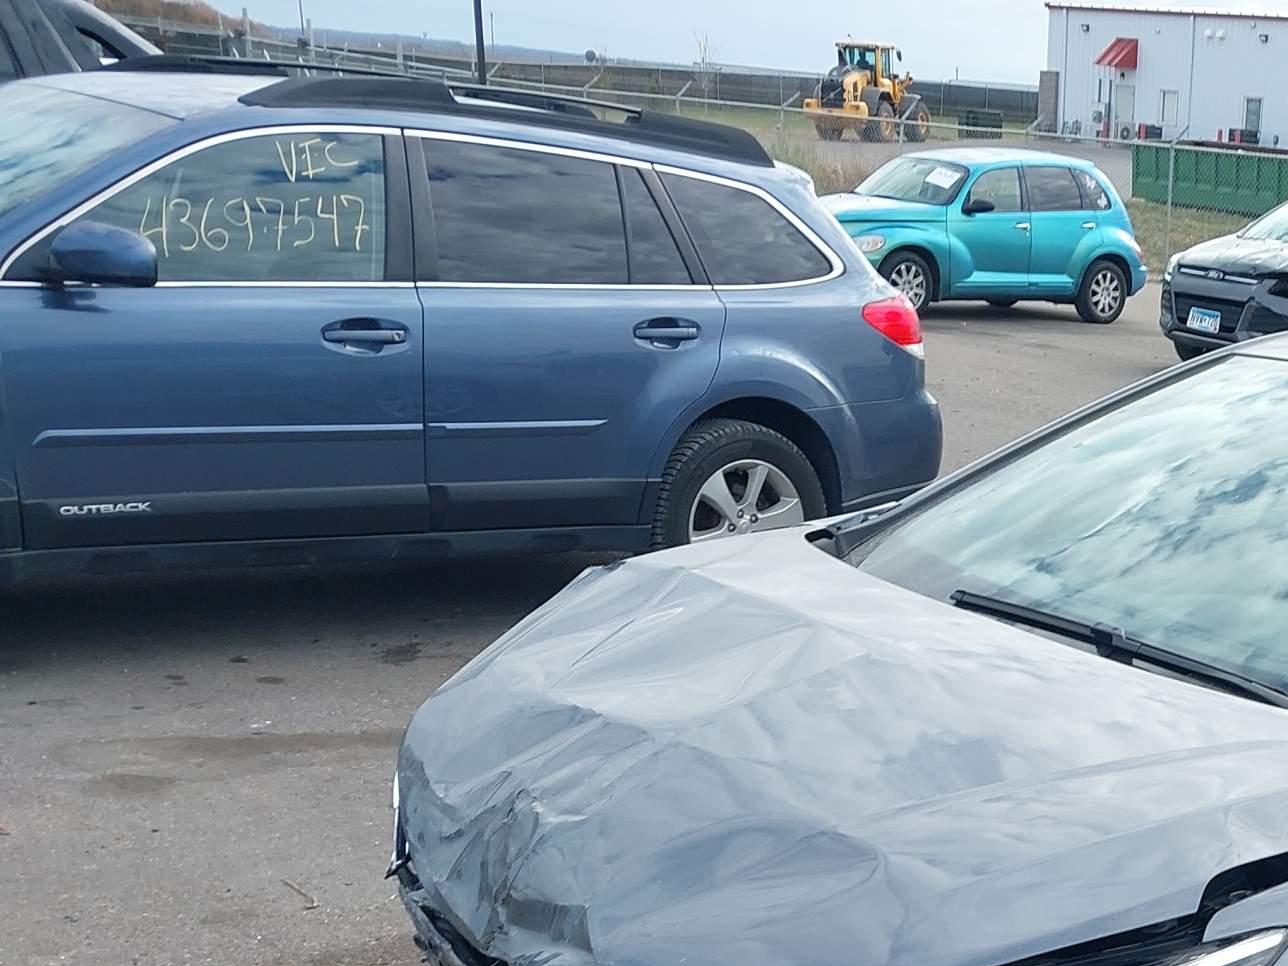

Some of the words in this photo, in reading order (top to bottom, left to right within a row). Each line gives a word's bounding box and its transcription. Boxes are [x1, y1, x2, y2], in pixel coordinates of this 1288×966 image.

[275, 138, 359, 183] VIC
[139, 194, 370, 258] 43697547
[59, 501, 153, 516] OUTBACK
